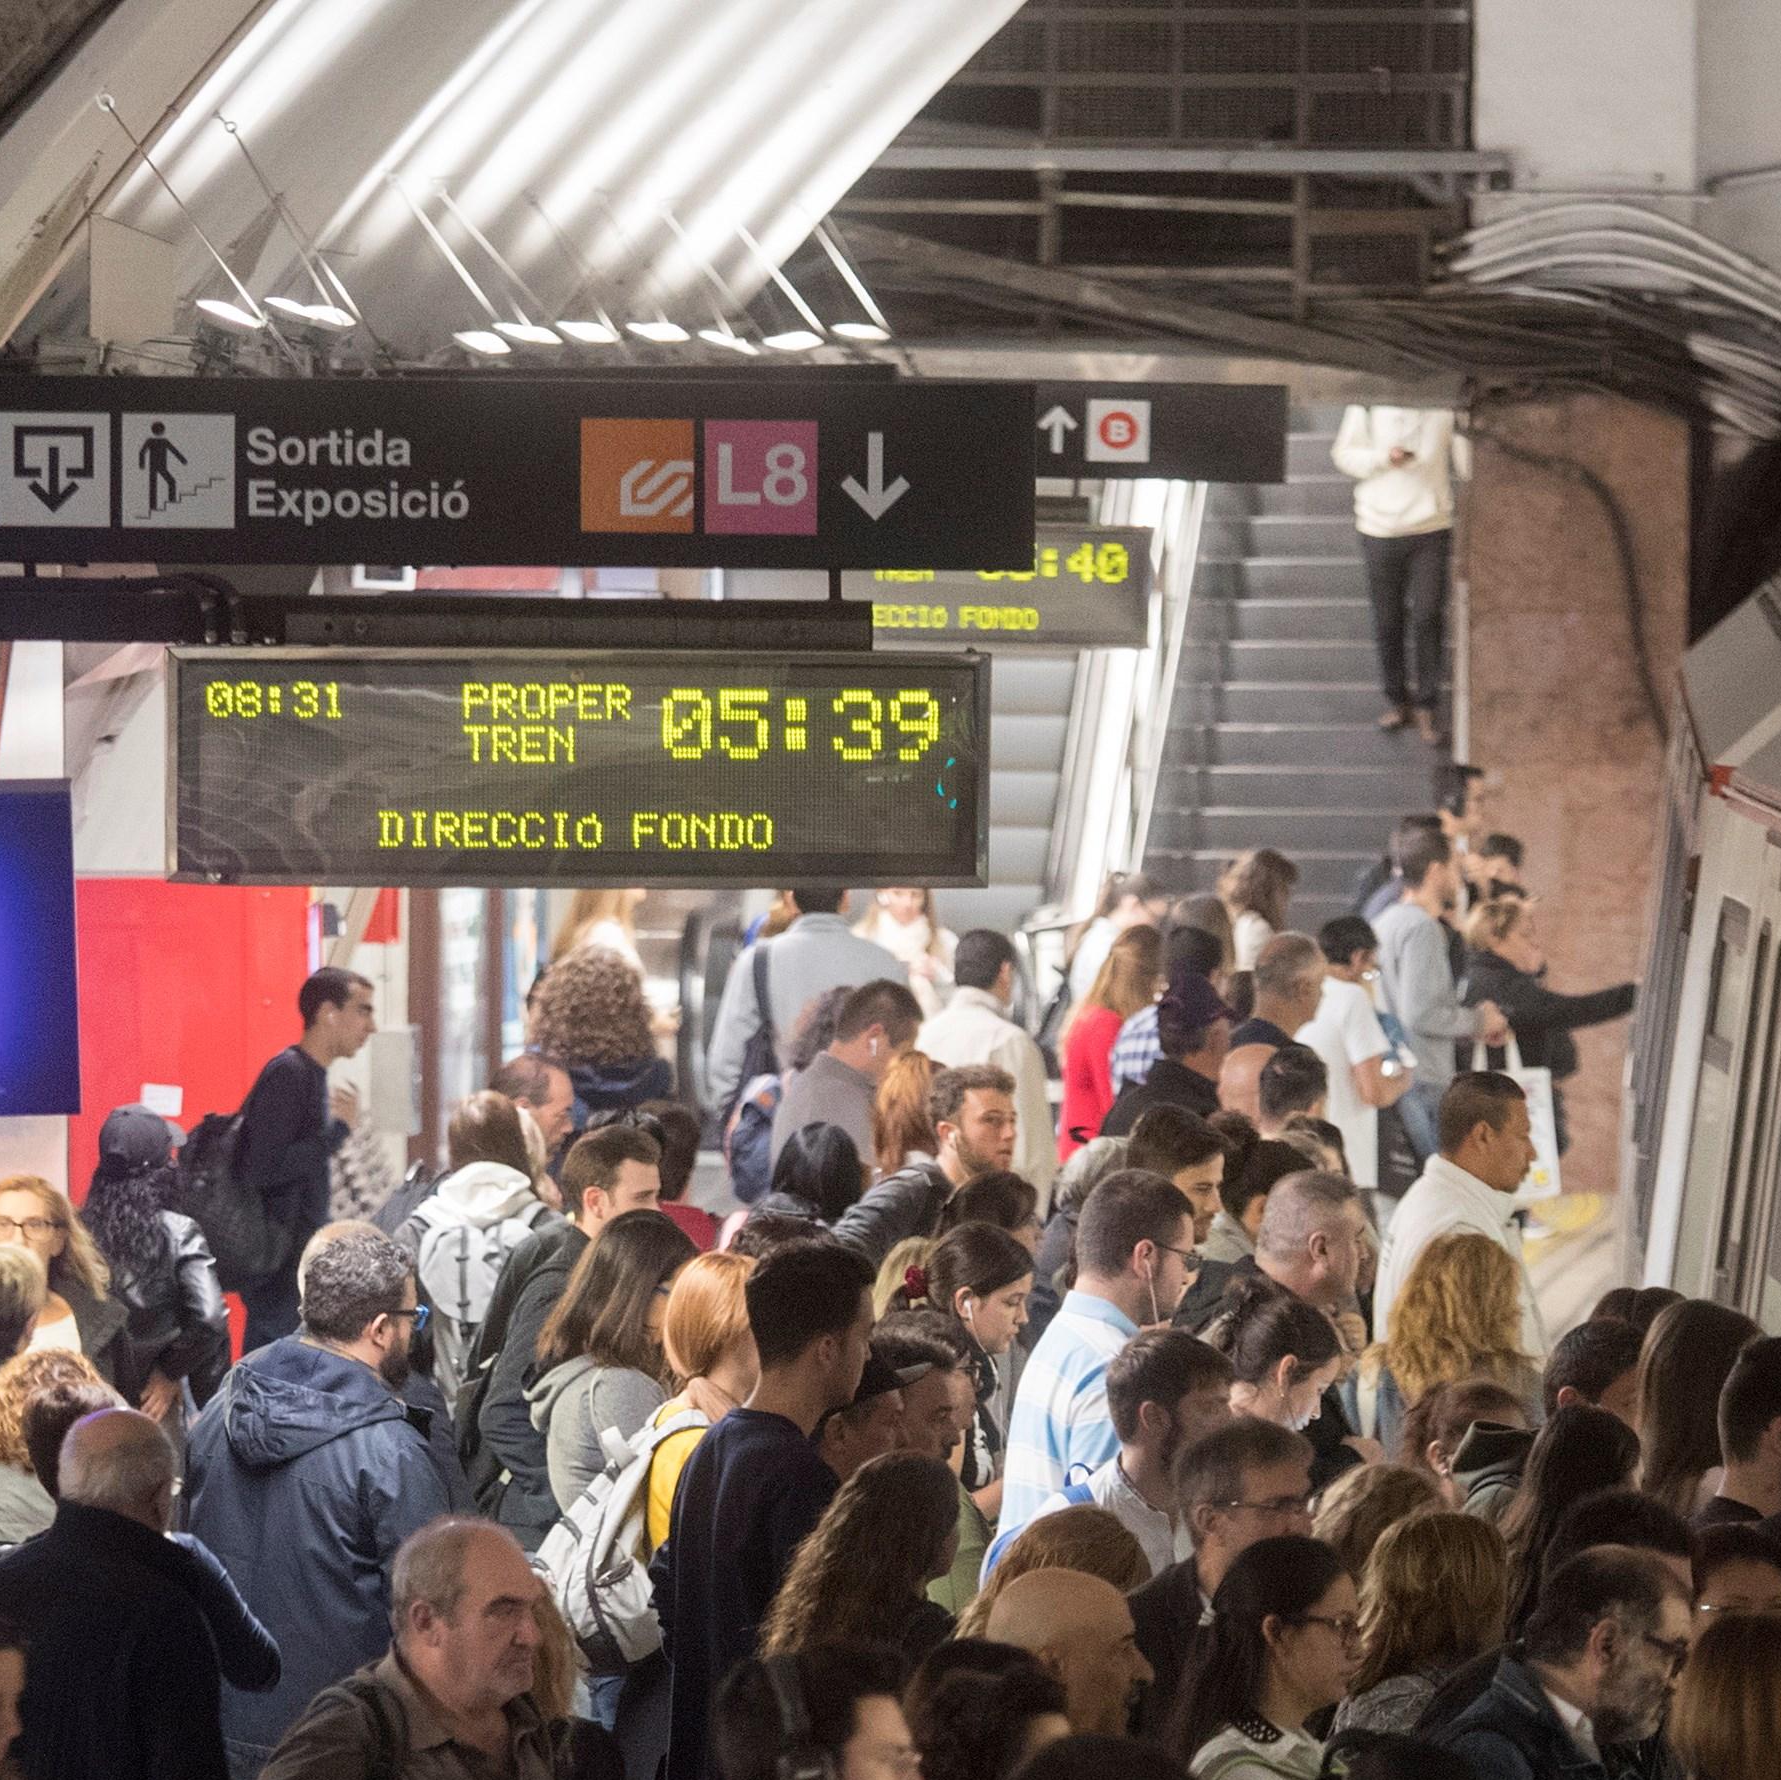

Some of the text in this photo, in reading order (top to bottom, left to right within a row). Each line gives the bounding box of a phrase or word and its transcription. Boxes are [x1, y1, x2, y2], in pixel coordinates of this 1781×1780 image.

[246, 427, 411, 466] Sortida
[717, 442, 808, 506] L8
[247, 479, 469, 526] Exposició
[959, 605, 1040, 631] FONDO
[206, 681, 342, 718] 08:31
[462, 683, 631, 720] PROPER
[662, 688, 940, 761] 05:39
[463, 725, 575, 763] TREN
[632, 812, 773, 848] FONDO
